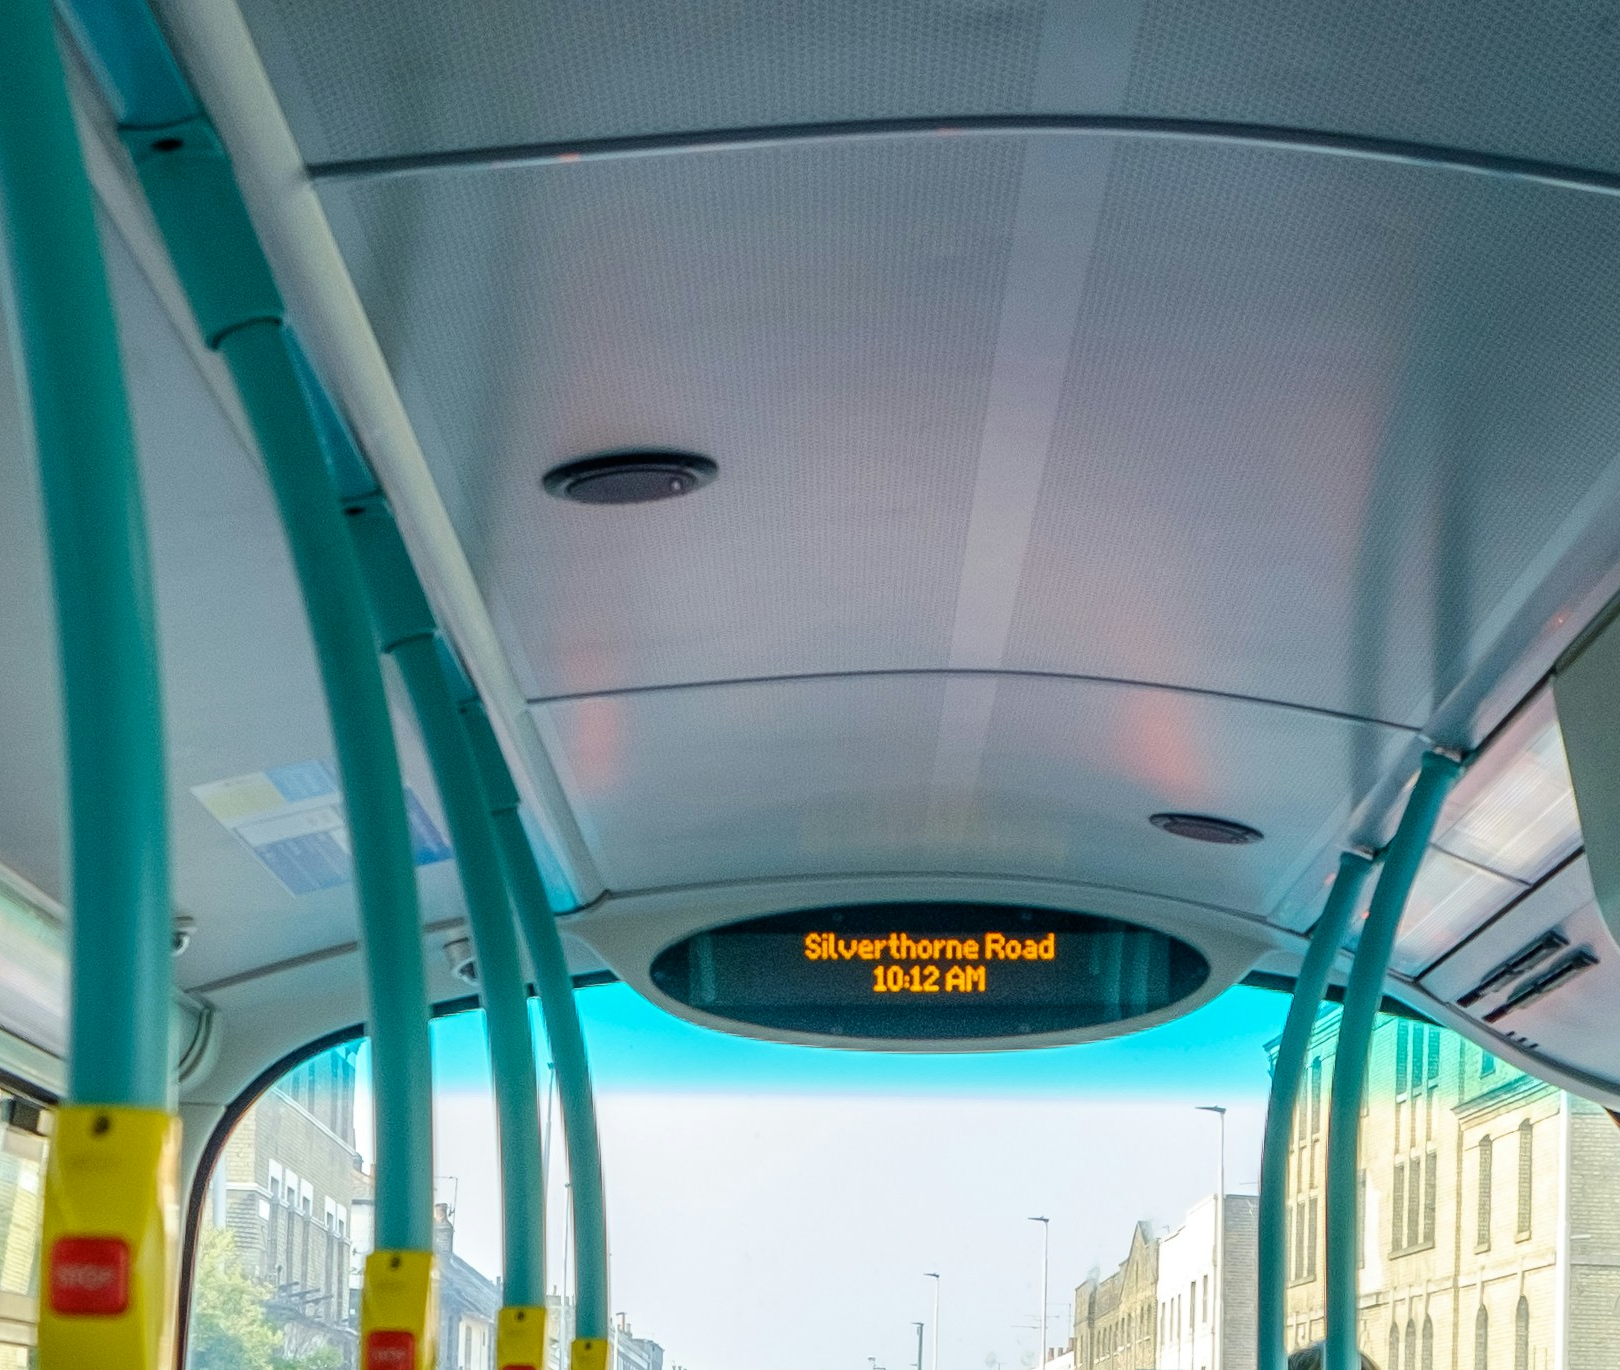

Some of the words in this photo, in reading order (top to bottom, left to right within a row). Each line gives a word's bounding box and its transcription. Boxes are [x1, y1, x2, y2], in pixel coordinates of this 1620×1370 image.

[804, 932, 980, 961] Silverthorne
[984, 932, 1055, 961] Road
[872, 964, 941, 993] 10:12
[944, 964, 986, 993] AM
